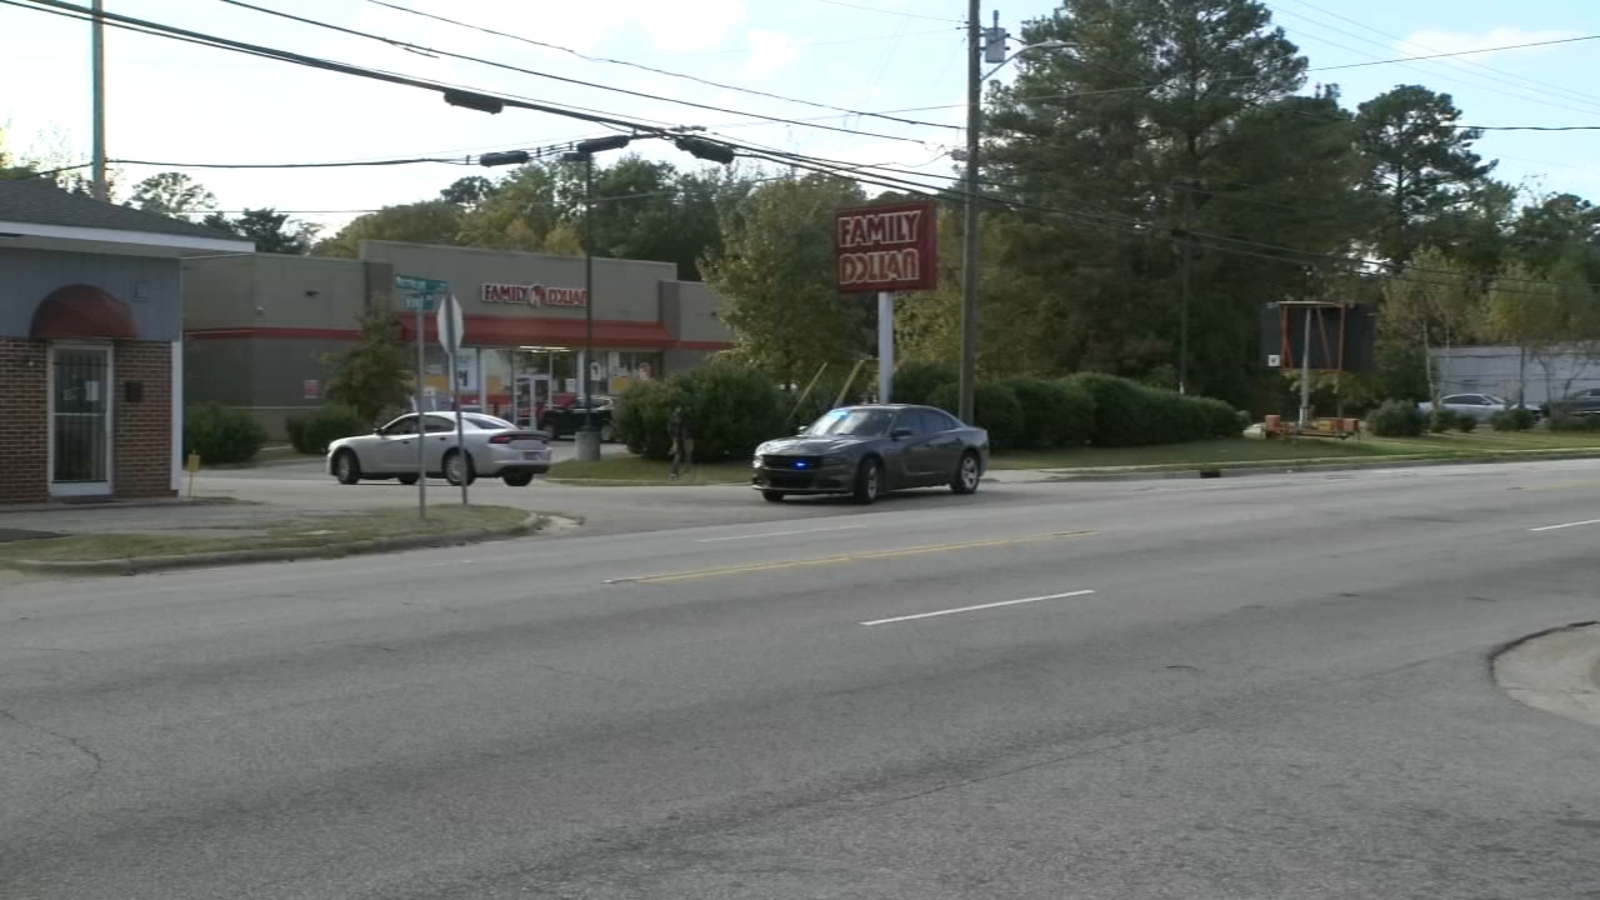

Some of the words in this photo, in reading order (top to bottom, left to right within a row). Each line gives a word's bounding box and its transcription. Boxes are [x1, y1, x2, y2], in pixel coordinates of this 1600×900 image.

[839, 210, 921, 248] FAMILY
[839, 248, 920, 285] DOLLAR
[480, 284, 530, 303] FAMILY
